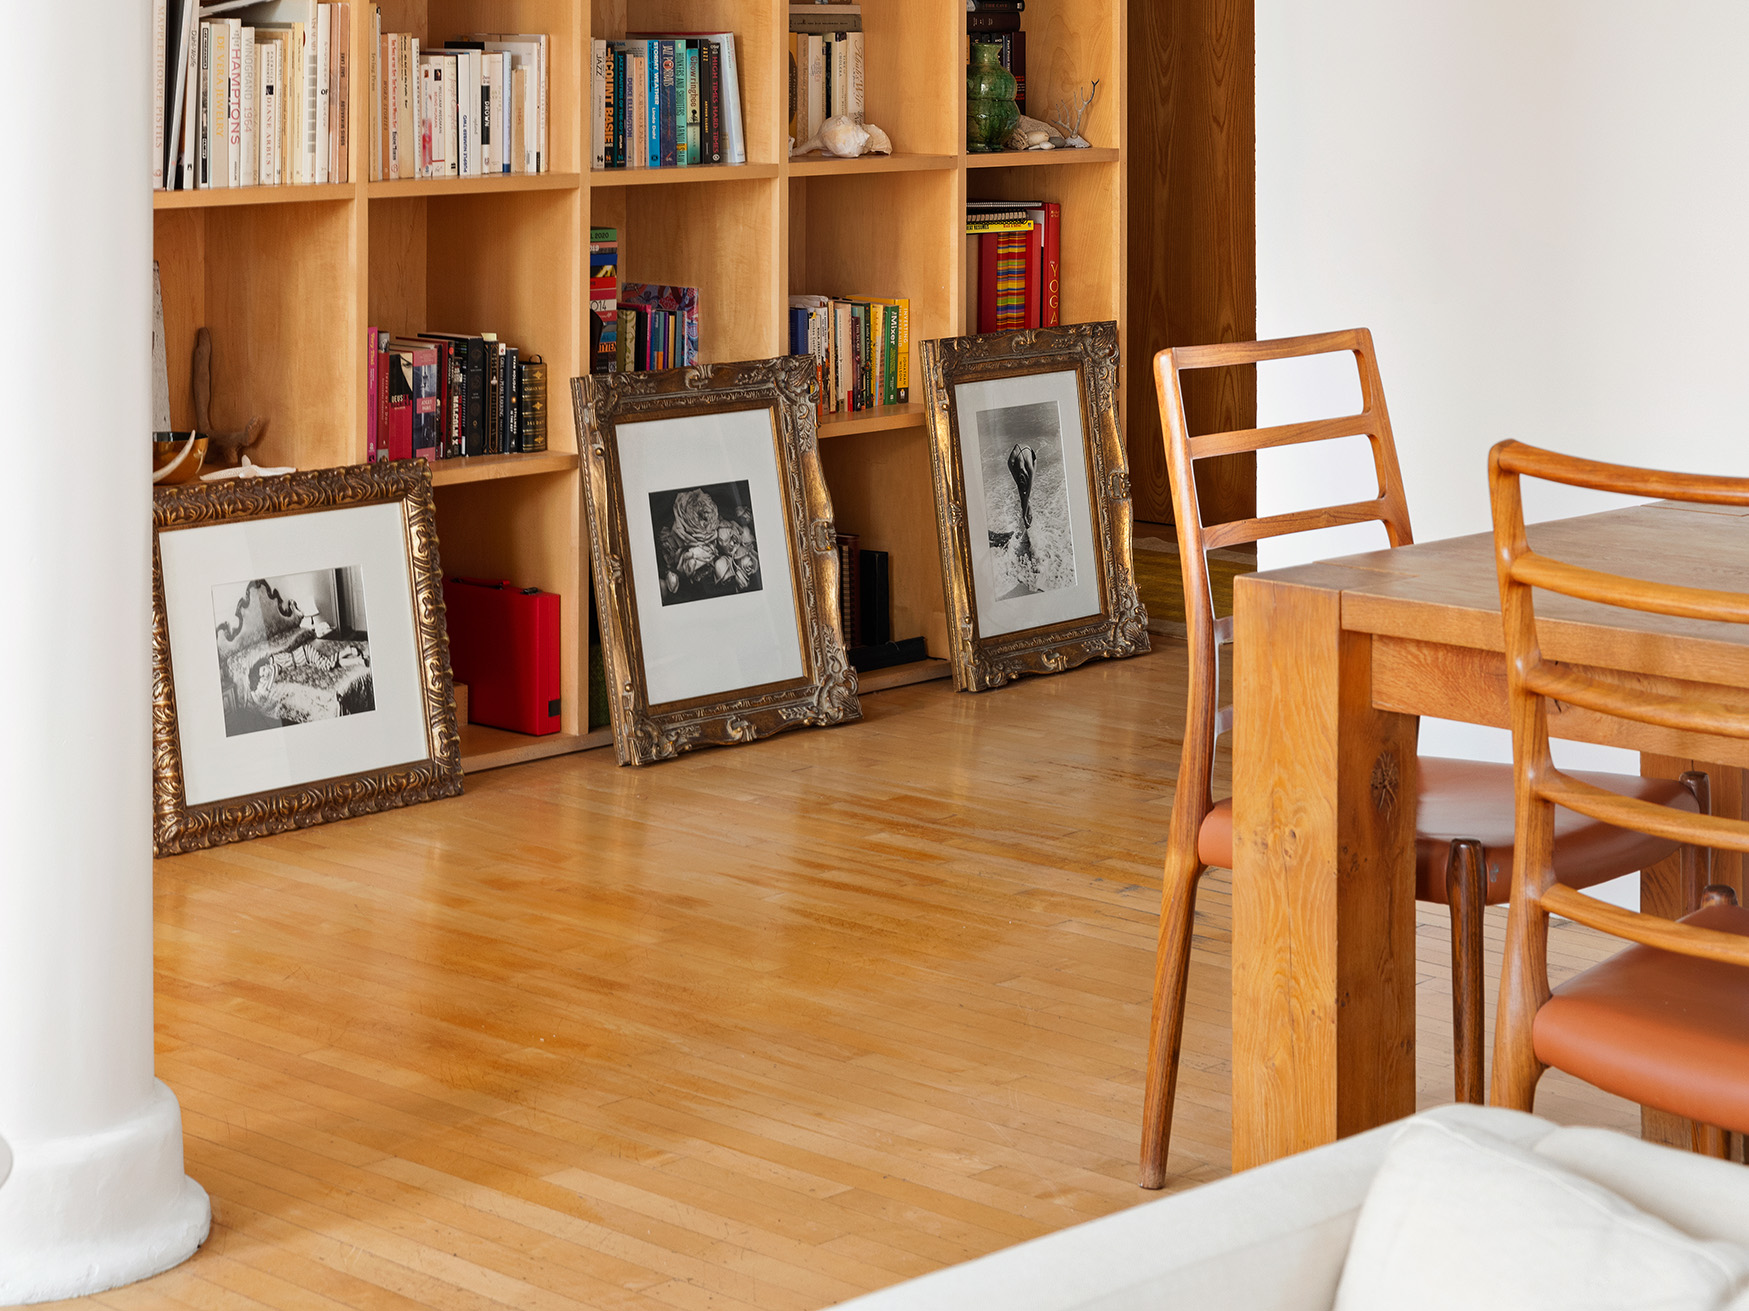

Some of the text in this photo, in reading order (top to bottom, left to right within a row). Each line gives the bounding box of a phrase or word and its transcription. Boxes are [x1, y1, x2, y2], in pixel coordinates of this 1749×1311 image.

[156, 5, 164, 149] MAPPLETHORPE PISTILS
[215, 36, 225, 138] DE VERA JEWELRY
[231, 48, 240, 145] HAMPTONS
[244, 38, 253, 100] WINOGRAND
[605, 62, 613, 142] COUNT BASIE
[676, 53, 684, 117] HONKERS AND SHOUTERS
[244, 107, 253, 133] 1964
[1050, 264, 1059, 324] YOGA
